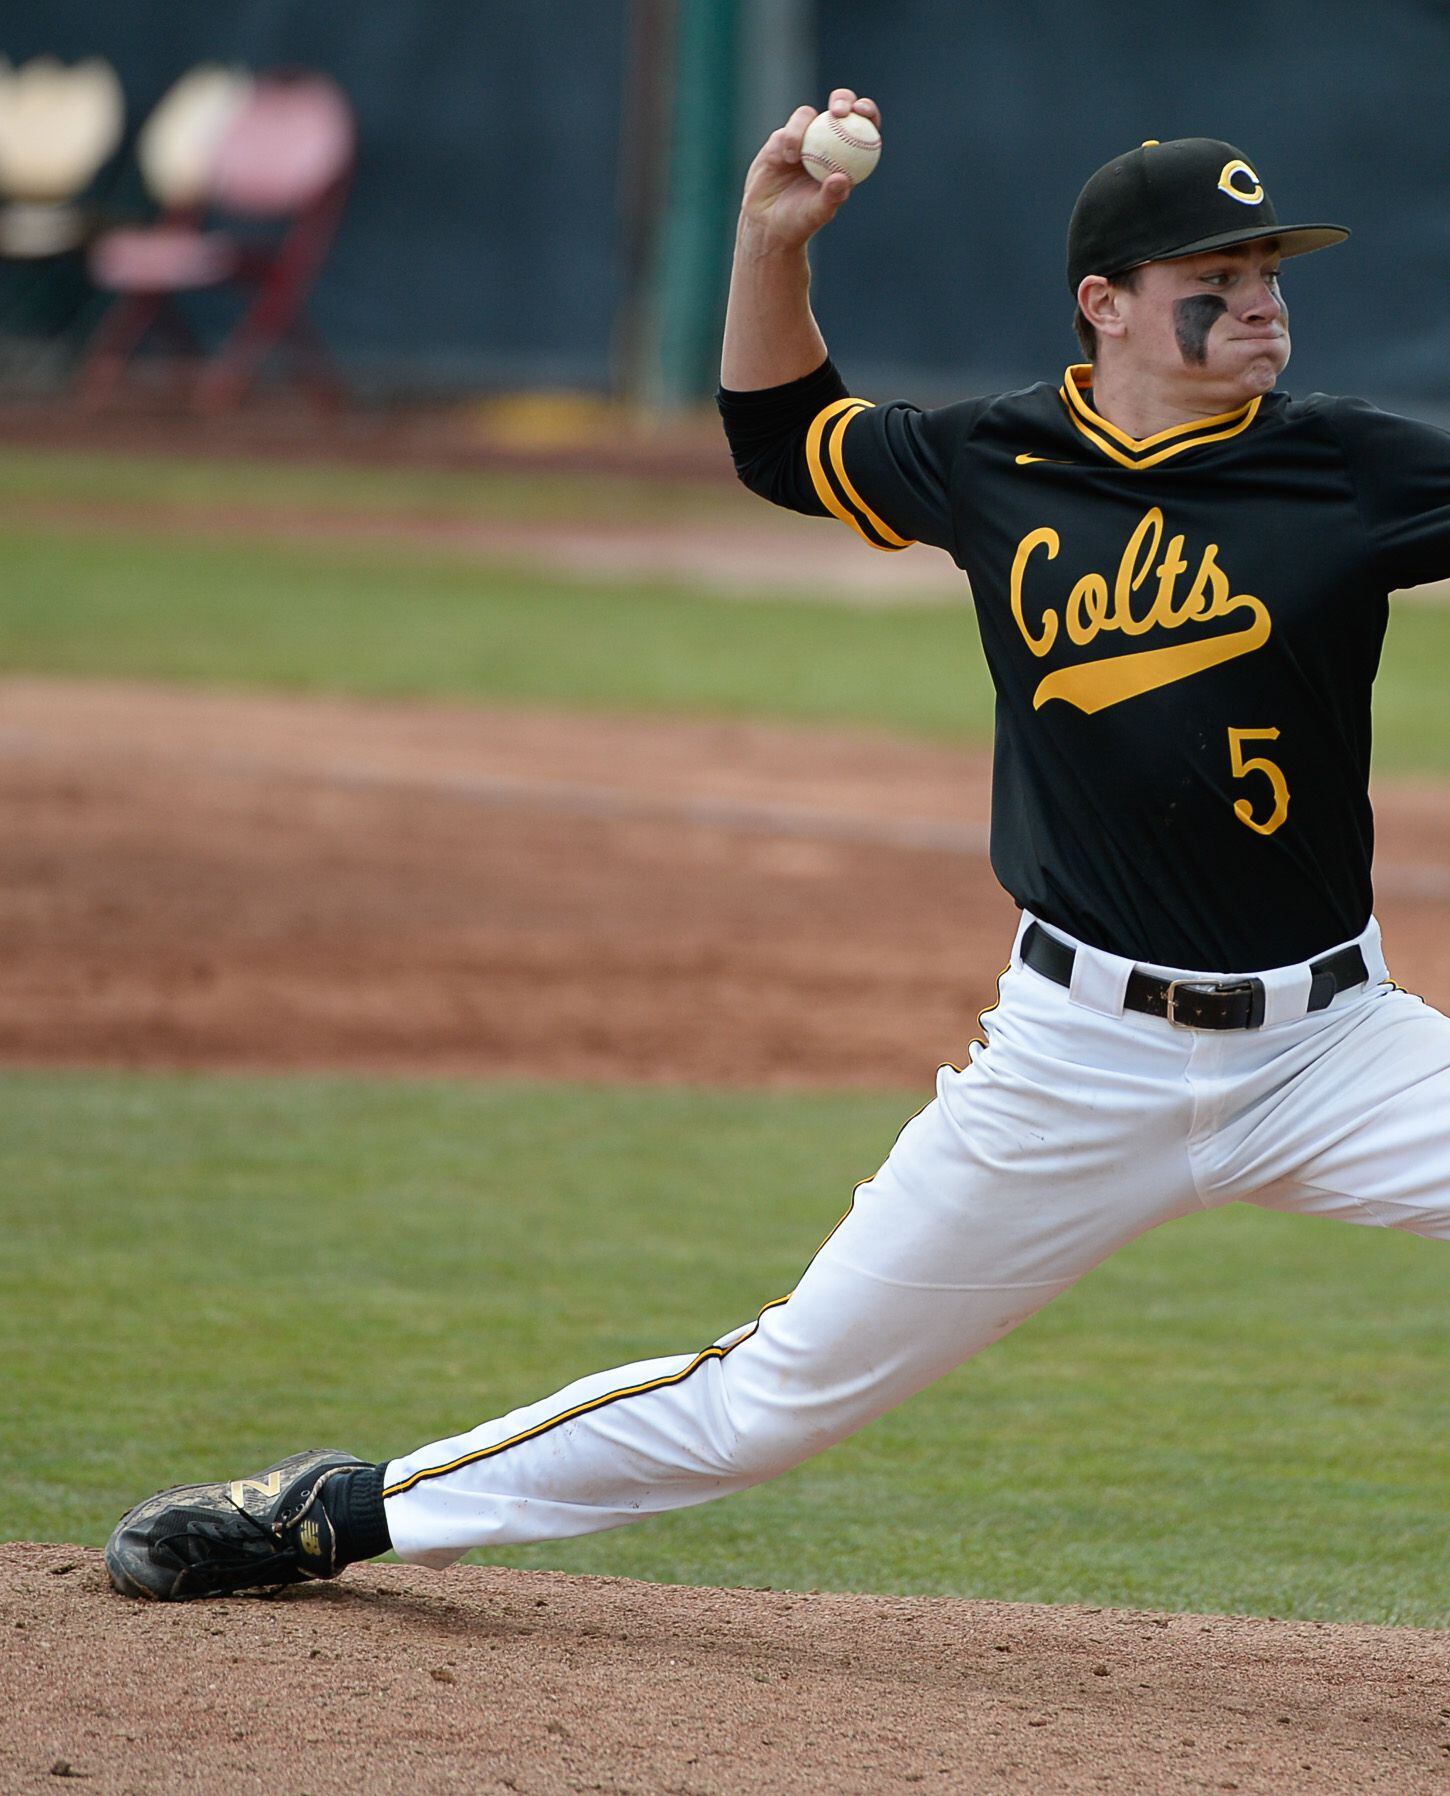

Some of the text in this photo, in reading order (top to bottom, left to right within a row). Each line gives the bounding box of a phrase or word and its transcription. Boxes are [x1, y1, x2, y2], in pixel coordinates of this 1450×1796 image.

[1217, 159, 1264, 205] C
[1010, 506, 1233, 657] Colts
[1228, 726, 1291, 835] 5
